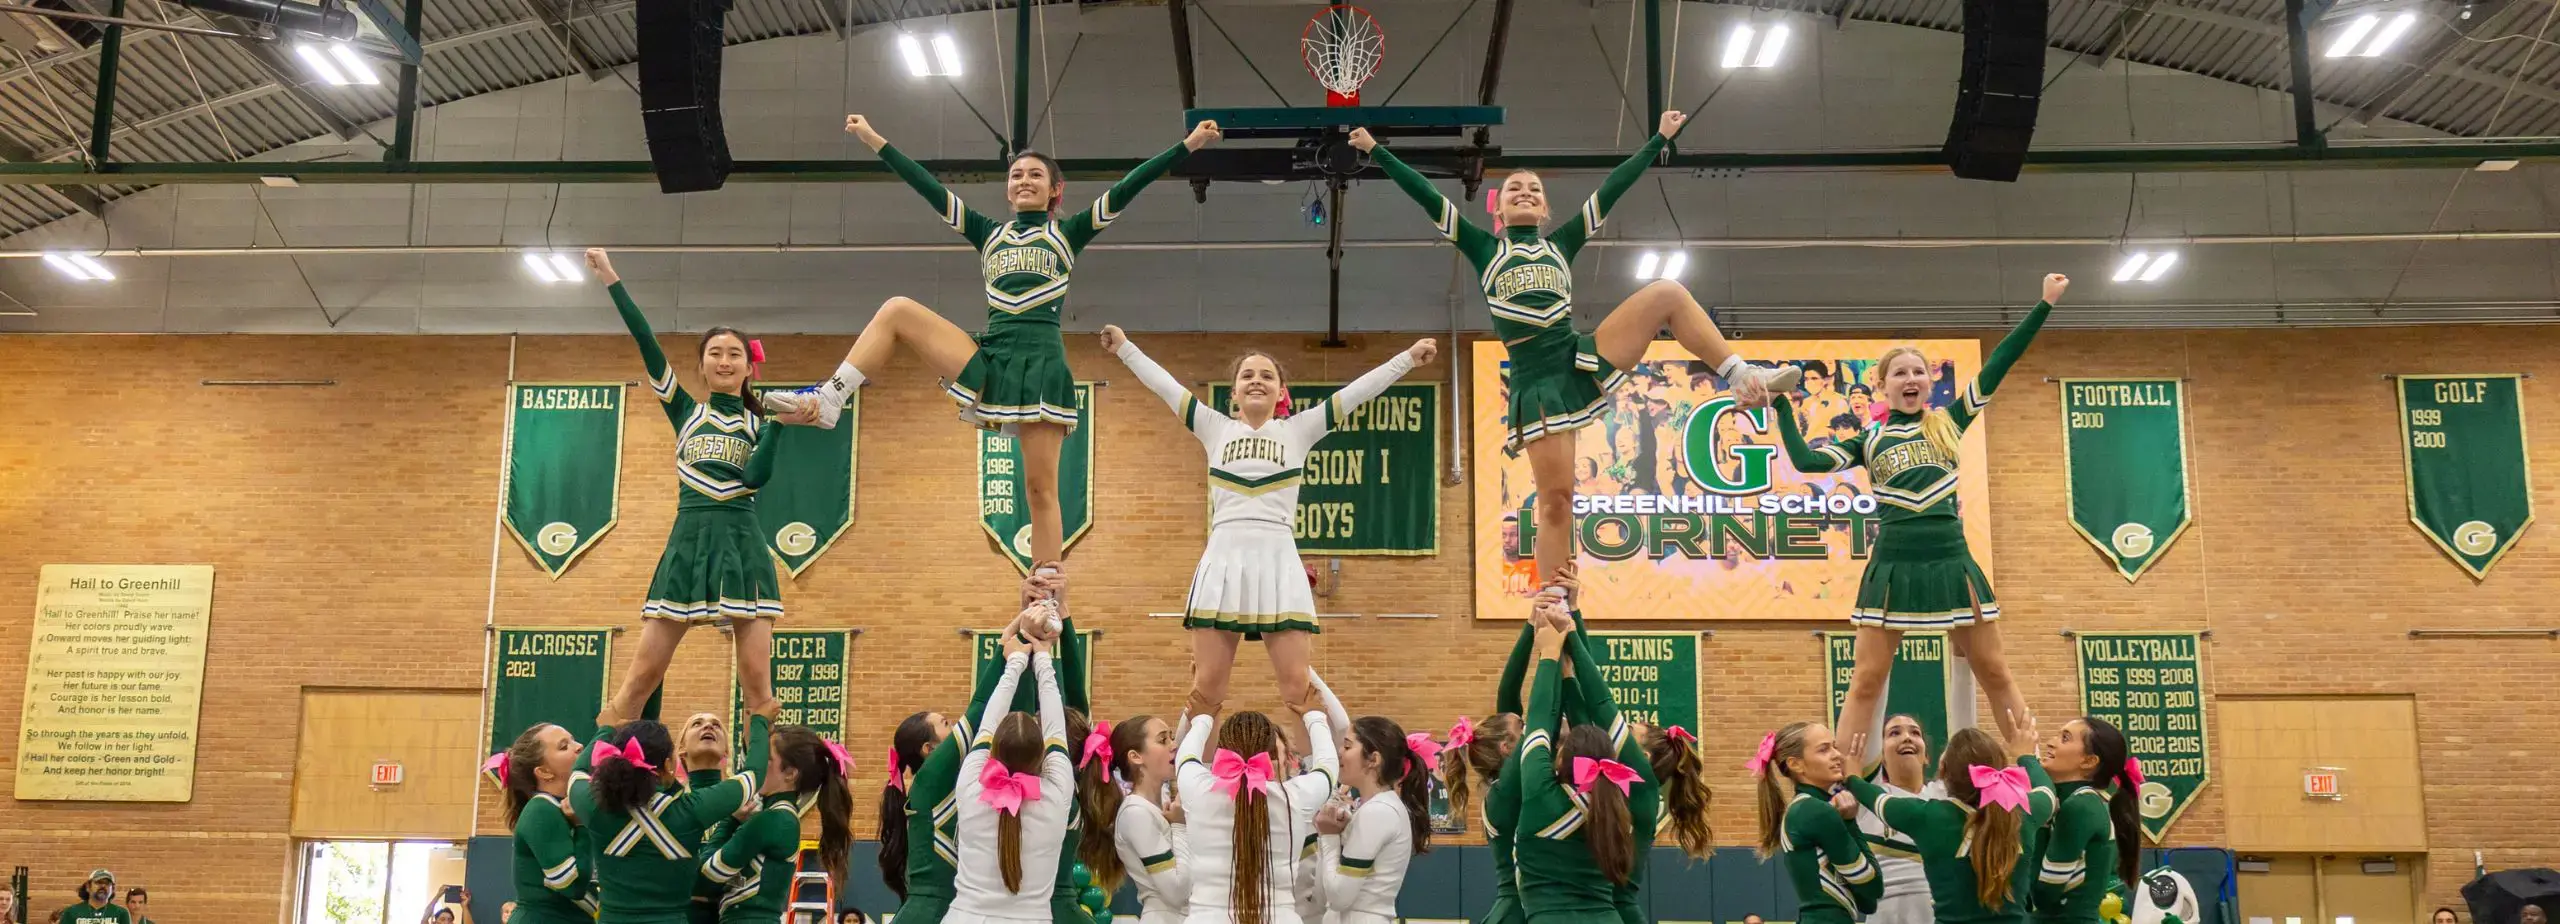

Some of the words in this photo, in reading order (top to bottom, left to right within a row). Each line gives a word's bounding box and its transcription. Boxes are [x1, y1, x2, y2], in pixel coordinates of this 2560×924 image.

[986, 248, 1060, 281] GREENHILL
[522, 388, 614, 410] BASEBALL
[2071, 384, 2171, 407] FOOTBALL
[2433, 381, 2488, 404] GOLF
[2071, 411, 2104, 429] 2000
[2411, 409, 2441, 426] 1999
[986, 436, 1012, 453] 1981
[1682, 396, 1777, 496] G
[2412, 430, 2446, 448] 2000
[1221, 437, 1286, 467] GREENHILL
[986, 458, 1014, 475] 1982
[1380, 448, 1390, 484] I
[986, 479, 1013, 496] 1983
[984, 498, 1013, 515] 2006
[1571, 494, 1754, 515] GREENHILL
[1758, 494, 1877, 515] SCHOO
[1295, 502, 1356, 539] BOYS
[1517, 507, 1882, 560] HORNET
[70, 577, 96, 590] Hail
[100, 579, 113, 590] to
[118, 577, 181, 590] Greenhill
[65, 611, 73, 619] to
[124, 610, 152, 619] Praise
[154, 611, 169, 619] her
[65, 622, 80, 630] Her
[83, 622, 111, 630] colors
[113, 622, 148, 632] proudly
[46, 633, 81, 642] Onward
[83, 635, 113, 643] moves
[115, 634, 130, 643] her
[132, 634, 166, 645] guiding
[507, 634, 599, 656] LACROSSE
[66, 645, 73, 654] A
[76, 646, 99, 655] spirit
[102, 646, 119, 654] true
[121, 647, 138, 655] and
[1606, 638, 1674, 661] TENNIS
[1901, 639, 1941, 661] FIELD
[2083, 639, 2195, 662] VOLLEYBALL
[46, 670, 63, 678] Her
[65, 671, 84, 680] past
[96, 671, 124, 681] happy
[127, 671, 146, 679] with
[506, 660, 536, 678] 2021
[776, 664, 804, 681] 1987
[810, 664, 839, 680] 1998
[2088, 667, 2120, 685] 1985
[2125, 667, 2157, 685] 1999
[2160, 667, 2194, 685] 2008
[62, 682, 79, 690] Her
[81, 682, 108, 690] future
[775, 686, 803, 703] 1988
[807, 686, 841, 703] 2002
[50, 693, 88, 703] Courage
[91, 694, 99, 702] is
[101, 694, 116, 702] her
[118, 694, 148, 702] lesson
[2089, 690, 2121, 708] 1986
[2126, 691, 2159, 708] 2000
[2164, 691, 2195, 708] 2010
[57, 705, 76, 714] And
[78, 706, 105, 714] honor
[107, 706, 115, 714] is
[117, 706, 132, 714] her
[807, 708, 840, 725] 2003
[2128, 714, 2160, 731] 2001
[2166, 713, 2197, 731] 2011
[41, 729, 76, 740] through
[79, 730, 93, 738] the
[95, 731, 120, 740] years
[122, 731, 133, 739] as
[135, 730, 155, 741] they
[57, 742, 72, 750] We
[74, 742, 101, 750] follow
[104, 743, 113, 751] in
[115, 742, 130, 751] her
[2130, 736, 2166, 754] 2002
[2168, 736, 2200, 753] 2015
[30, 753, 48, 762] Hail
[50, 754, 65, 762] her
[67, 754, 95, 762] colors
[103, 754, 131, 763] Green
[133, 754, 150, 763] and
[153, 755, 175, 764] Gold
[2140, 759, 2168, 777] 003
[2170, 758, 2201, 776] 2017
[43, 766, 62, 774] And
[64, 766, 85, 776] keep
[88, 766, 103, 775] her
[105, 767, 132, 775] honor
[134, 767, 165, 777] bright!
[377, 765, 399, 781] EXIT
[2311, 775, 2333, 793] EXIT
